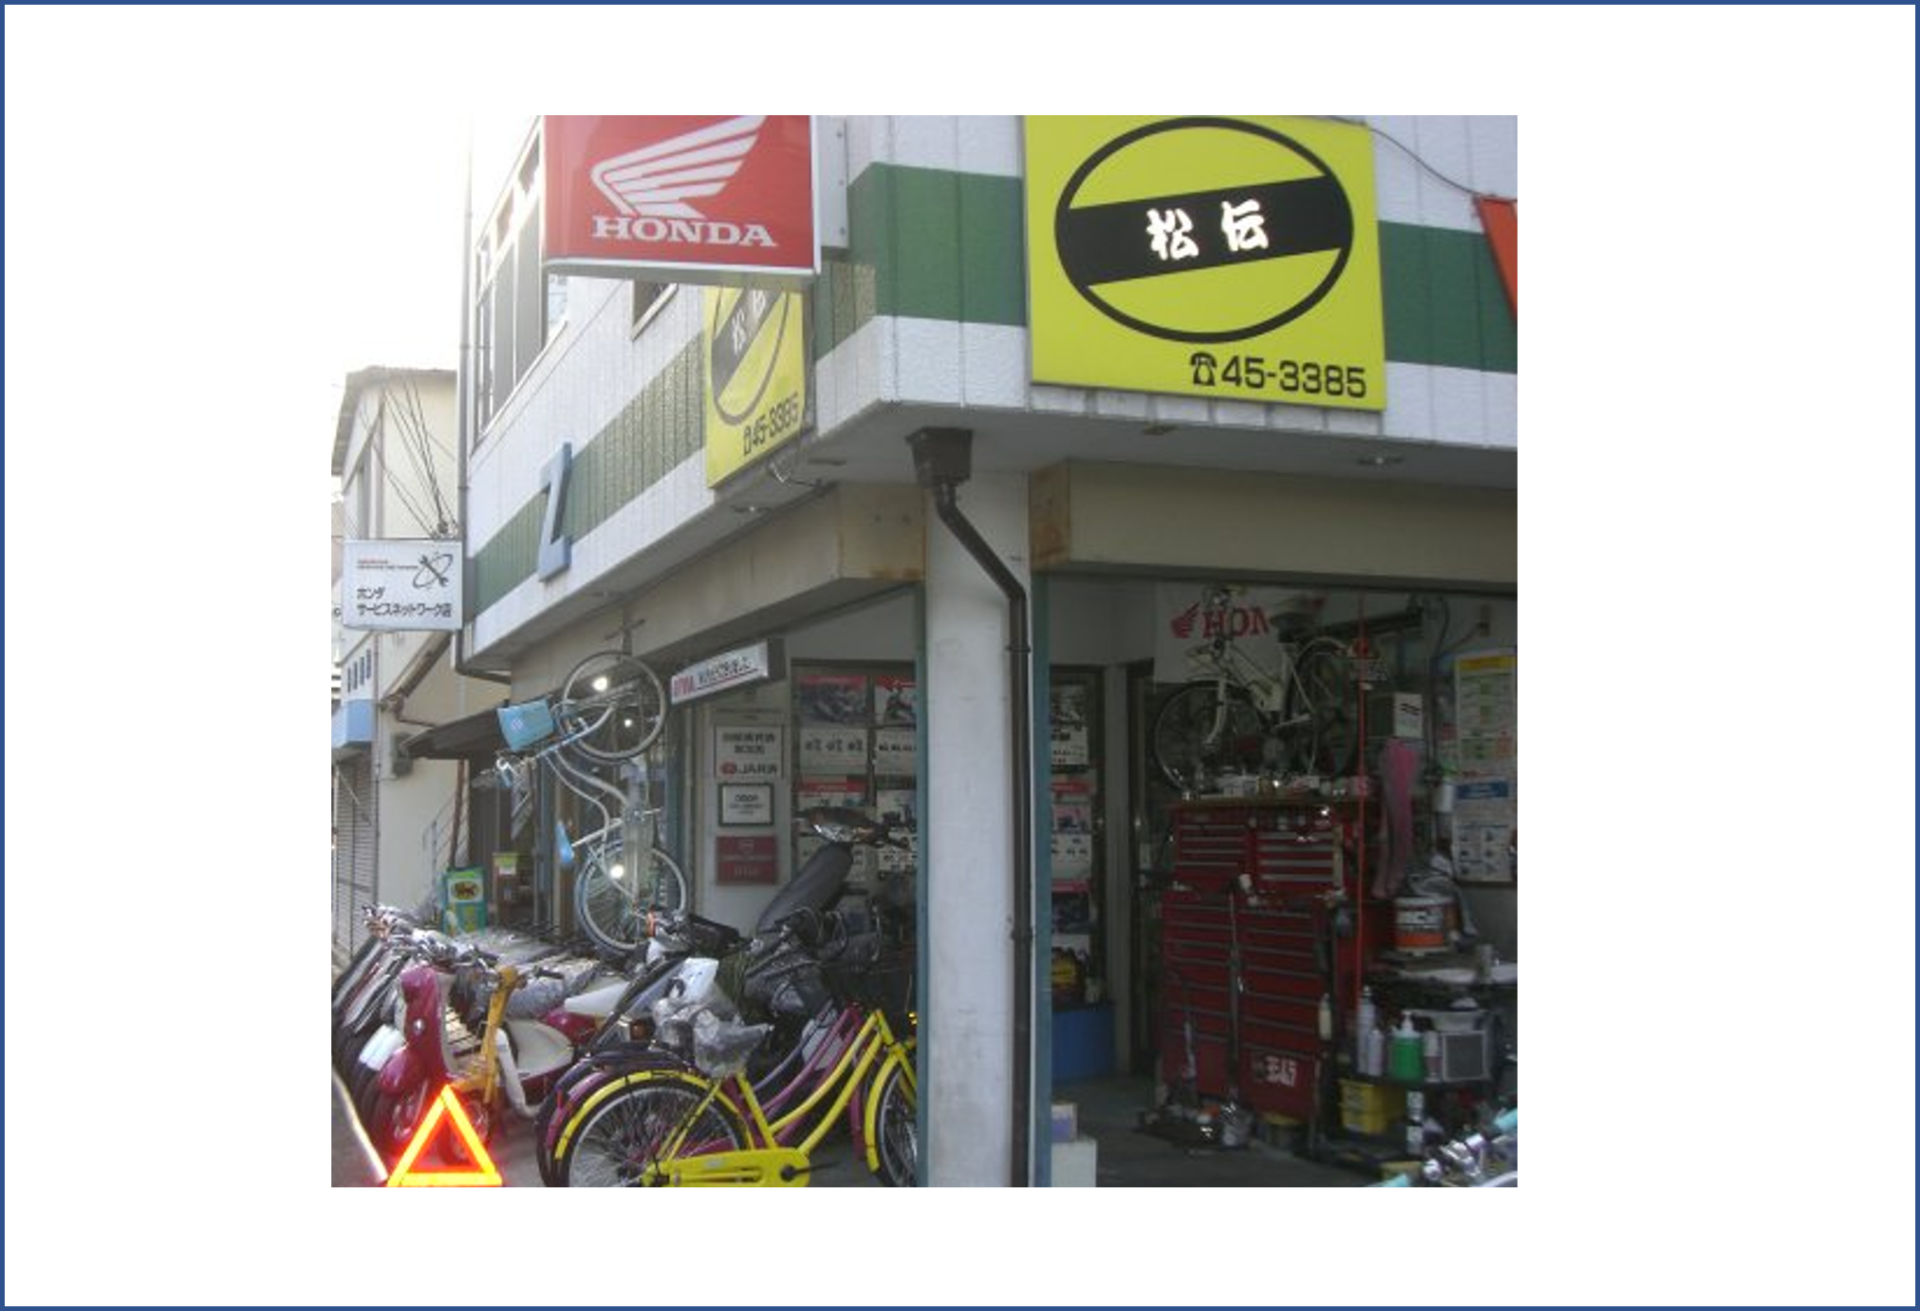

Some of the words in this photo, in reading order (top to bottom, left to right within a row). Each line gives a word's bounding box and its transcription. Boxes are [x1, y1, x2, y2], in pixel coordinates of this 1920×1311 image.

[592, 216, 778, 247] HONDA
[1146, 199, 1269, 260] 松伝
[1221, 356, 1366, 398] 45-3385
[357, 586, 386, 600] ホンダ
[357, 603, 452, 618] サービスネットワーク店
